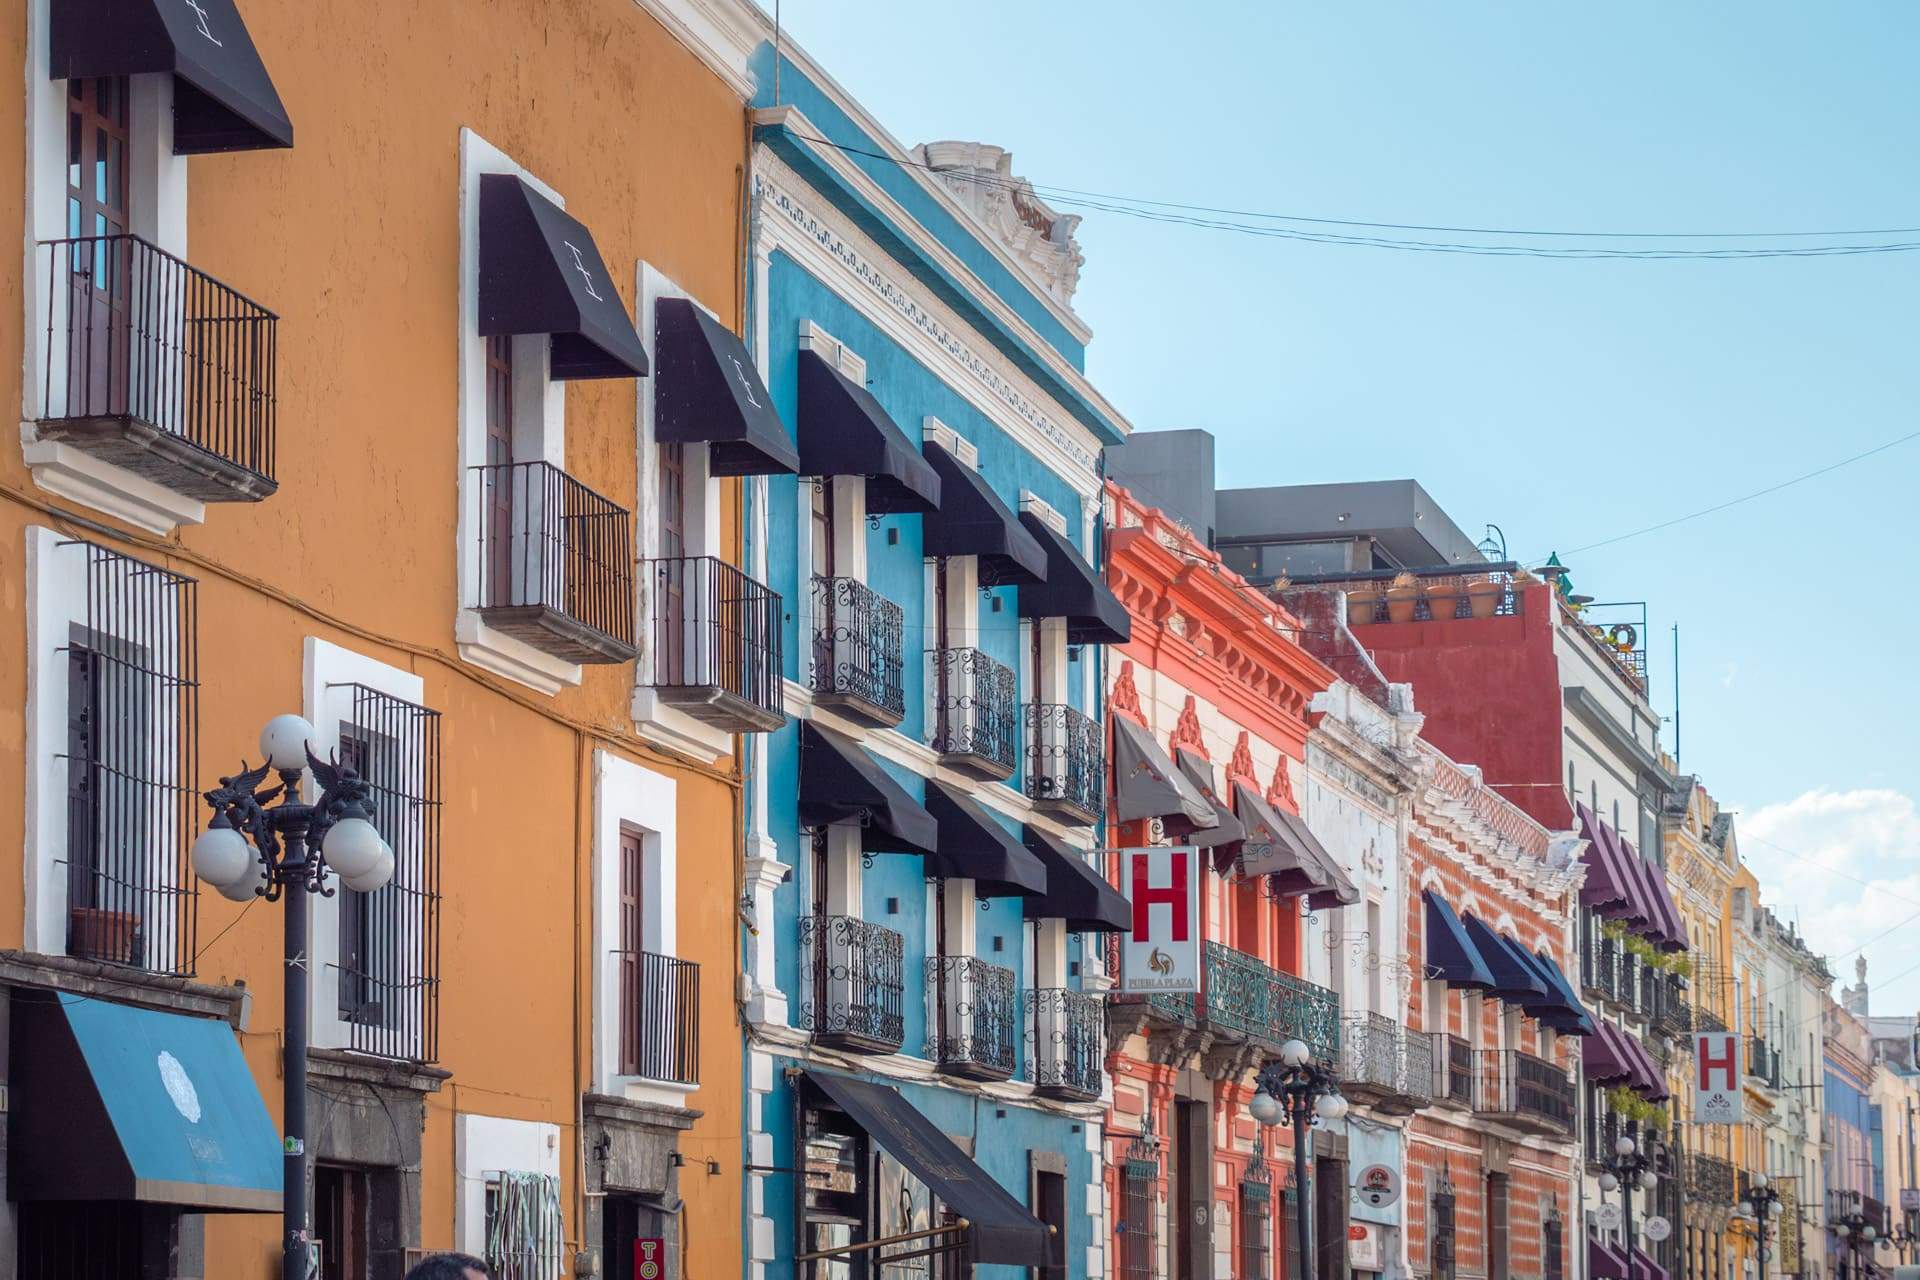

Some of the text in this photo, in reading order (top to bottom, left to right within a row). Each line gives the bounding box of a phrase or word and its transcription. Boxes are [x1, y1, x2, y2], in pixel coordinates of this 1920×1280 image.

[1132, 853, 1188, 942] H
[1128, 977, 1194, 988] PUEBLA PLAZA
[1699, 1036, 1736, 1091] H
